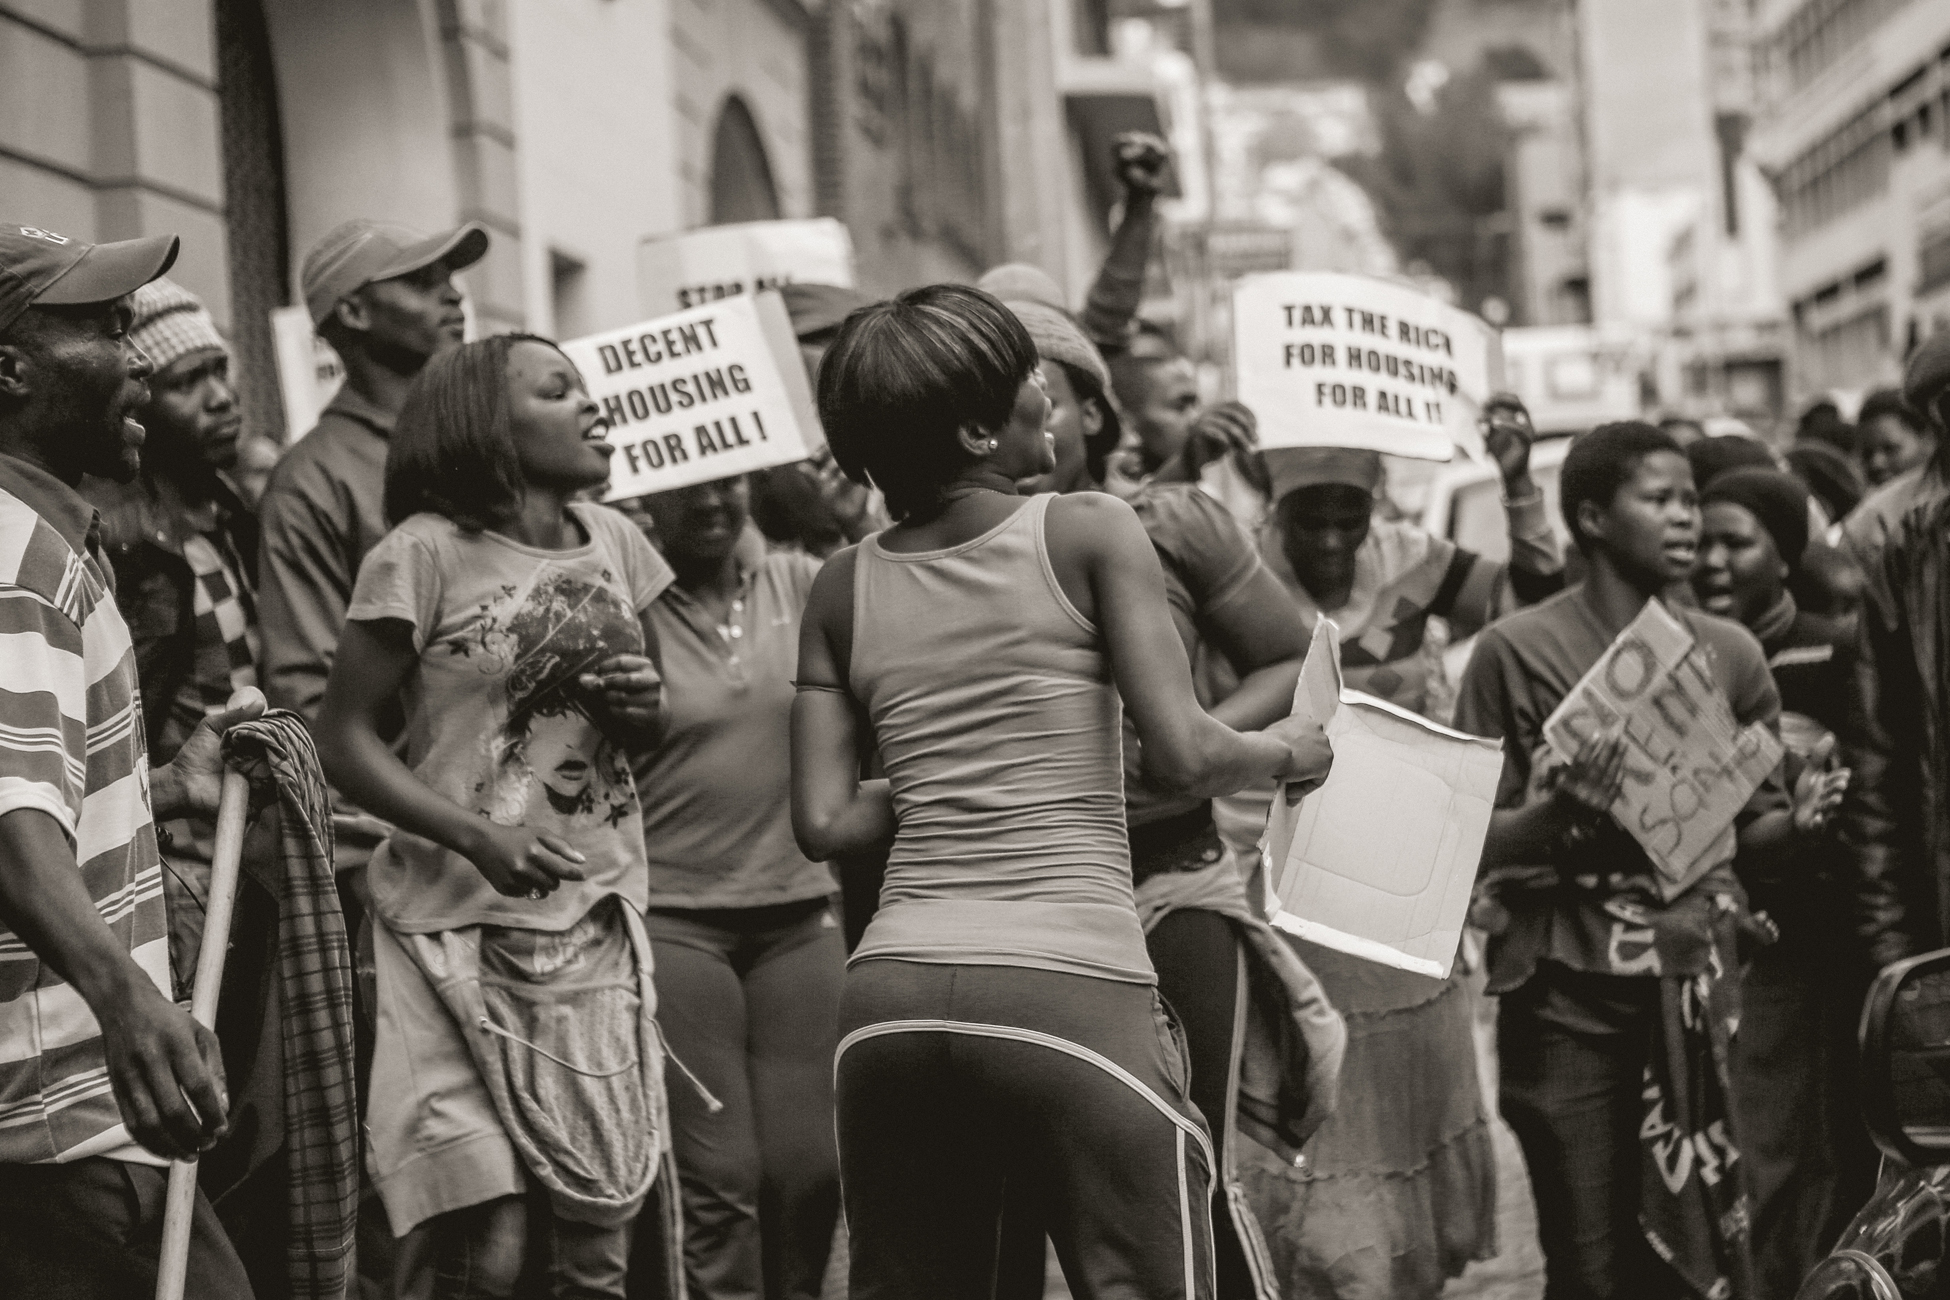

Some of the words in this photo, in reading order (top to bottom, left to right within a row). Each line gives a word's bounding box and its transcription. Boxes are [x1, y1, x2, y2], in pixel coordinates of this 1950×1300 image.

[1282, 305, 1334, 329] TAX
[1345, 307, 1388, 338] THE
[597, 319, 718, 375] DECENT
[1284, 343, 1336, 369] FOR
[603, 364, 751, 428] HOUSING
[1315, 383, 1366, 409] FOR
[1377, 390, 1416, 420] ALL
[623, 433, 689, 475] FOR
[694, 416, 751, 457] ALL
